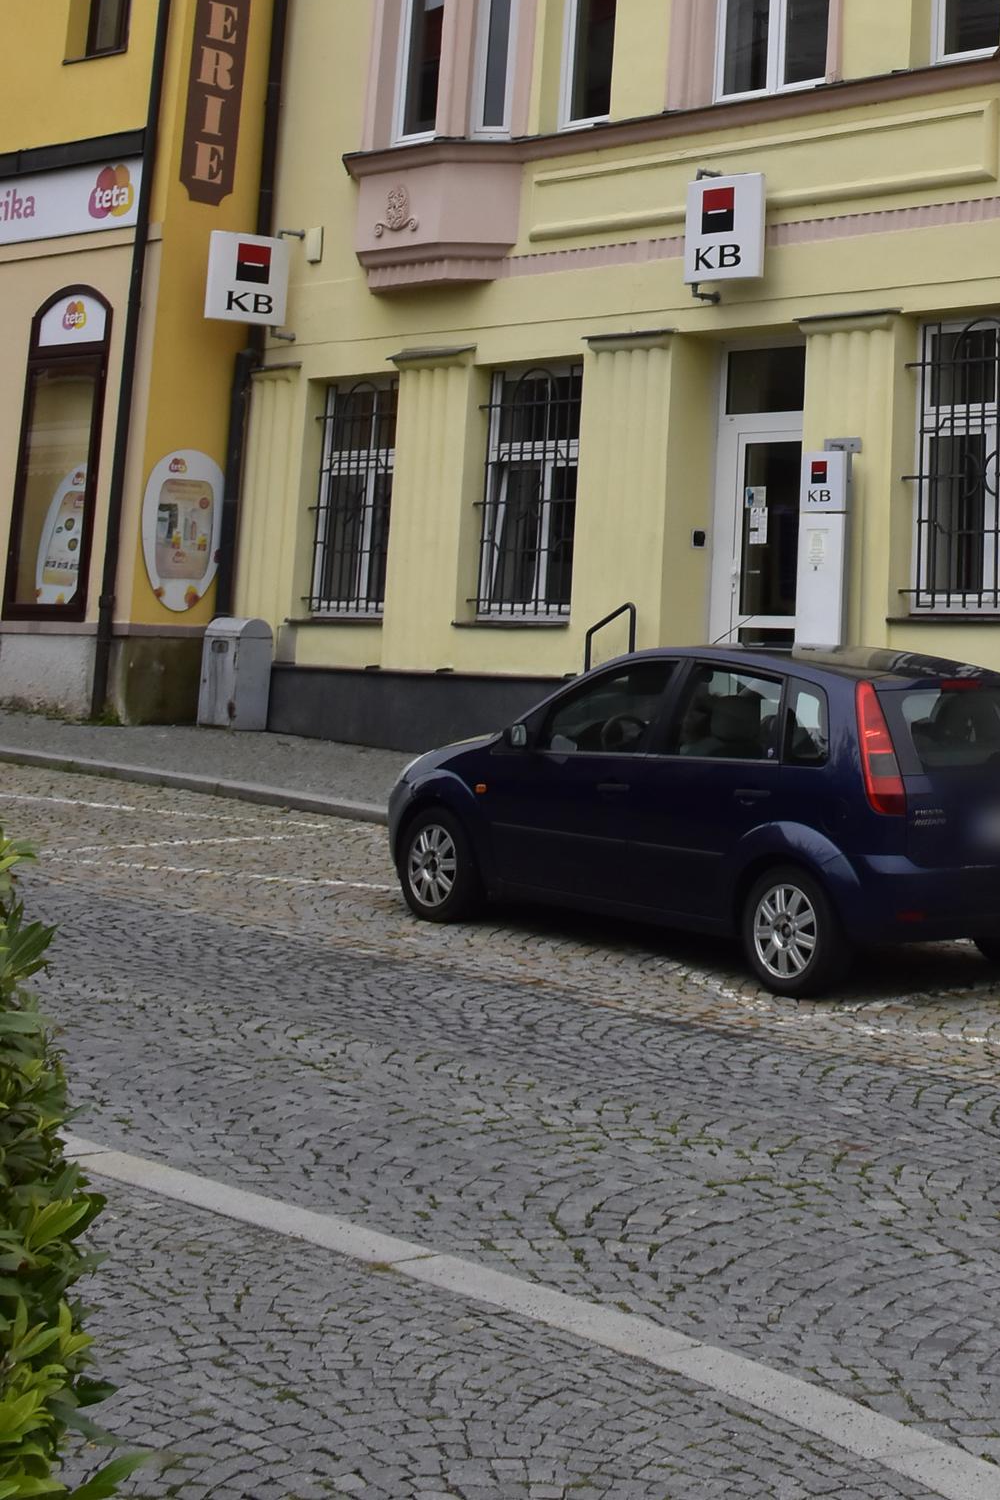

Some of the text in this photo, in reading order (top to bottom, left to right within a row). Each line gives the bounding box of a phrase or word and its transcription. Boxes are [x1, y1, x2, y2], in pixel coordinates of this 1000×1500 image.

[0, 188, 36, 221] ika
[94, 184, 130, 209] teta
[694, 243, 742, 272] KB
[225, 290, 273, 315] KB
[65, 311, 85, 325] teta
[807, 489, 831, 503] KB
